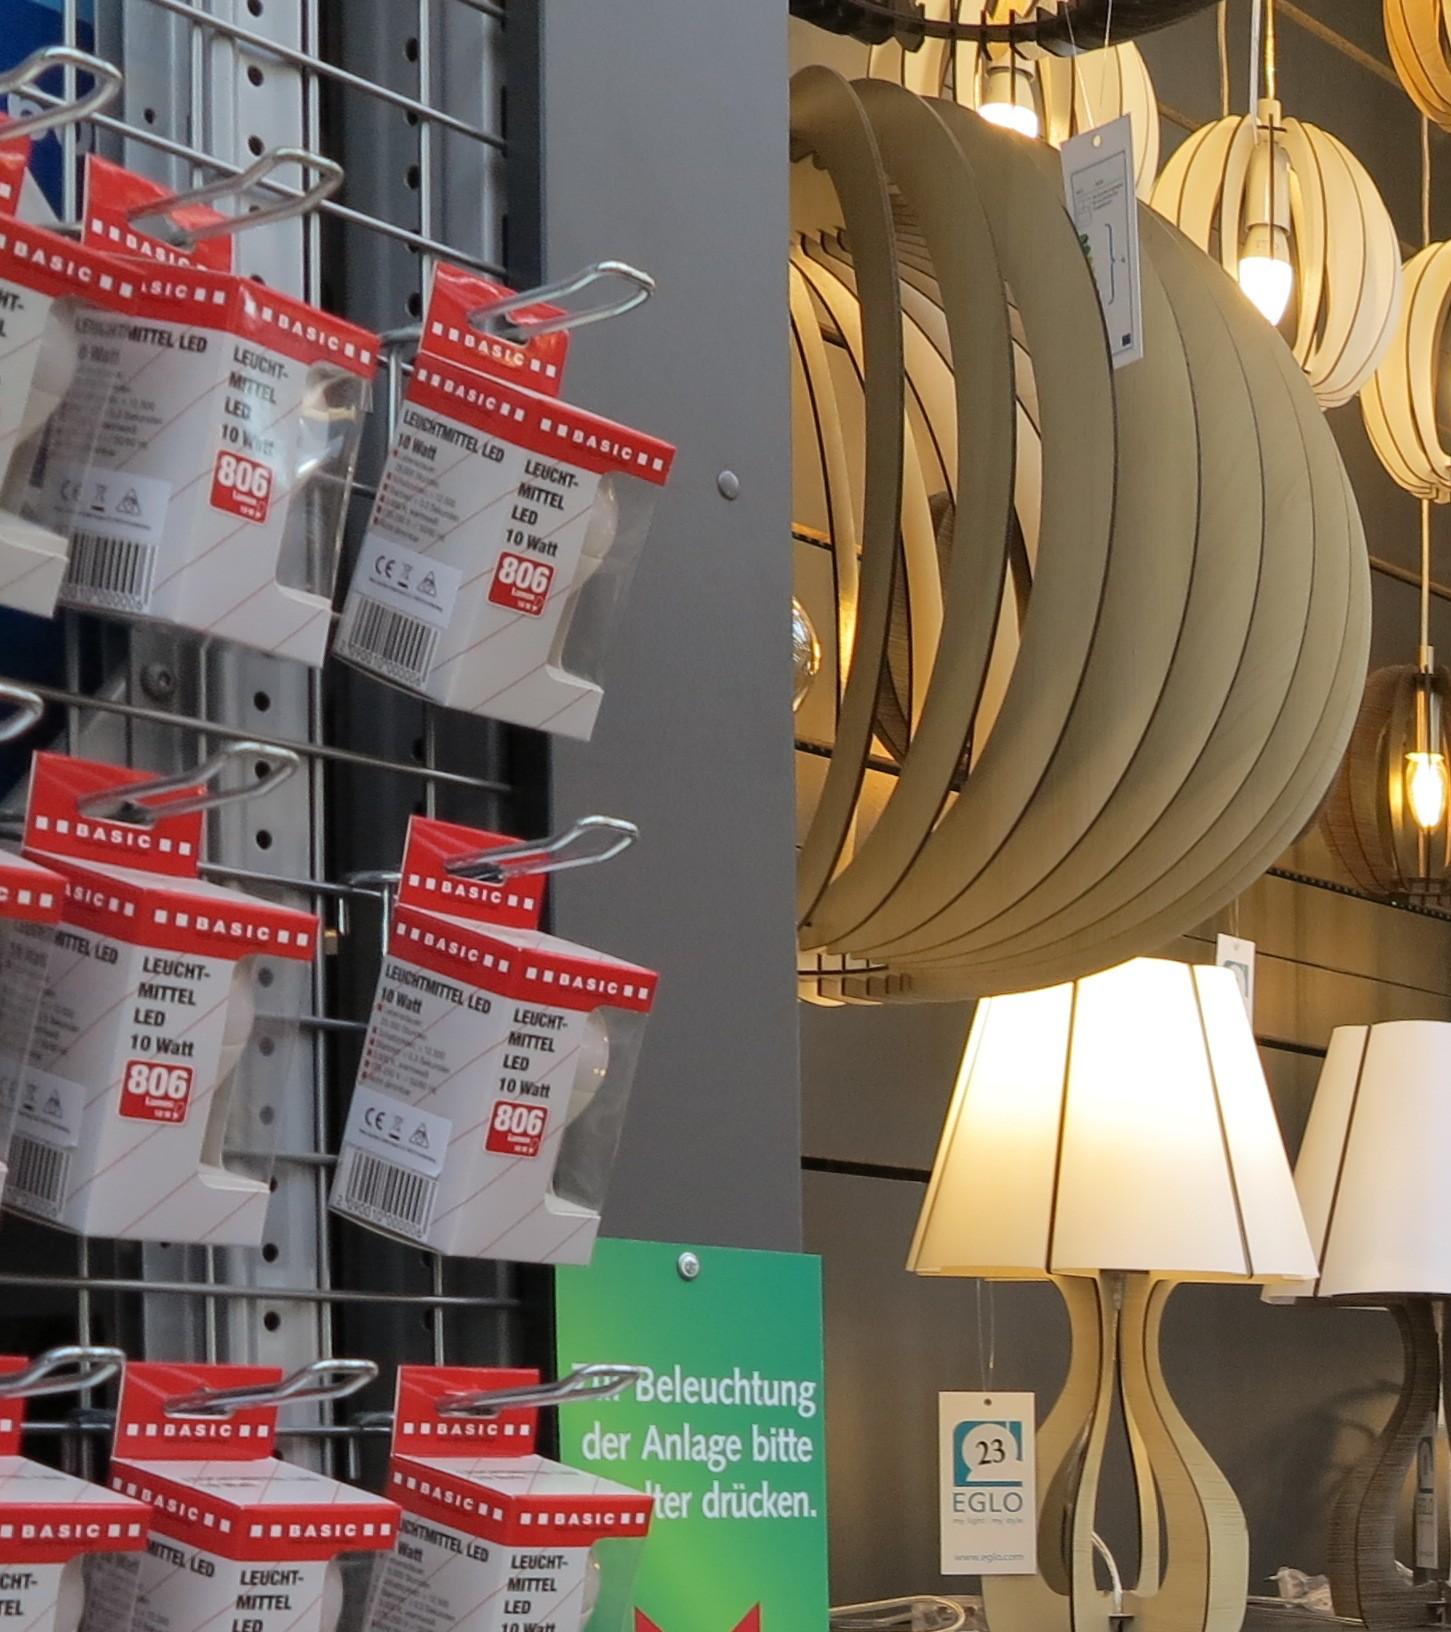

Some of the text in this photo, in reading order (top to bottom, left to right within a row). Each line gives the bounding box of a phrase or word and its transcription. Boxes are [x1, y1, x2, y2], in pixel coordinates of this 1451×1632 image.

[14, 241, 92, 282] BASIC
[179, 334, 208, 354] LED
[278, 314, 339, 350] BASIC
[464, 334, 525, 366] BASIC
[233, 346, 288, 379] LEUCHT-
[229, 371, 277, 405] MITTEL
[443, 380, 497, 410] BASIC
[224, 396, 252, 420] LED
[221, 423, 240, 444] 10
[403, 409, 505, 464] LEUCHTMITTEL LED
[572, 431, 633, 460] BASIC
[412, 438, 438, 462] Watt
[217, 455, 270, 498] 806
[525, 459, 580, 488] LEUCHT-
[517, 482, 565, 511] MITTEL
[511, 504, 538, 526] LED
[506, 528, 559, 558] 10 Watt
[498, 556, 549, 594] 806
[76, 823, 151, 848] BASIC
[441, 880, 502, 904] BASIC
[196, 916, 270, 940] BASIC
[94, 943, 118, 965] LED
[424, 932, 478, 962] BASIC
[142, 956, 211, 981] LEUCHT-
[138, 982, 197, 1006] MITTEL
[385, 962, 492, 1015] LEUCHTMITTEL LED
[558, 969, 618, 995] BASIC
[396, 992, 422, 1015] Watt
[133, 1007, 166, 1027] LED
[513, 1007, 568, 1031] LEUCHT-
[130, 1033, 194, 1057] 10 Watt
[507, 1031, 555, 1054] MITTEL
[503, 1053, 530, 1072] LED
[127, 1063, 189, 1100] 806
[499, 1076, 551, 1099] 10 Watt
[493, 1103, 545, 1136] 806
[636, 1363, 816, 1418] Beleuchtung
[163, 1423, 232, 1438] BASIC
[437, 1422, 499, 1436] BASIC
[581, 1421, 813, 1472] der Anlage bitte
[975, 1438, 1006, 1466] 23
[141, 1489, 199, 1521] BASIC
[420, 1481, 474, 1510] BASIC
[702, 1479, 817, 1519] drücken.
[952, 1491, 1024, 1514] EGLO
[21, 1524, 100, 1538] BASIC
[289, 1523, 357, 1538] BASIC
[554, 1512, 615, 1526] BASIC
[397, 1541, 424, 1564] Watt
[466, 1541, 490, 1563] LED
[510, 1554, 569, 1570] LEUCHT-
[190, 1554, 216, 1578] LED
[240, 1569, 304, 1587] LEUCHT-
[507, 1577, 558, 1593] MITTEL
[235, 1594, 292, 1611] MITTEL
[503, 1600, 531, 1615] LED
